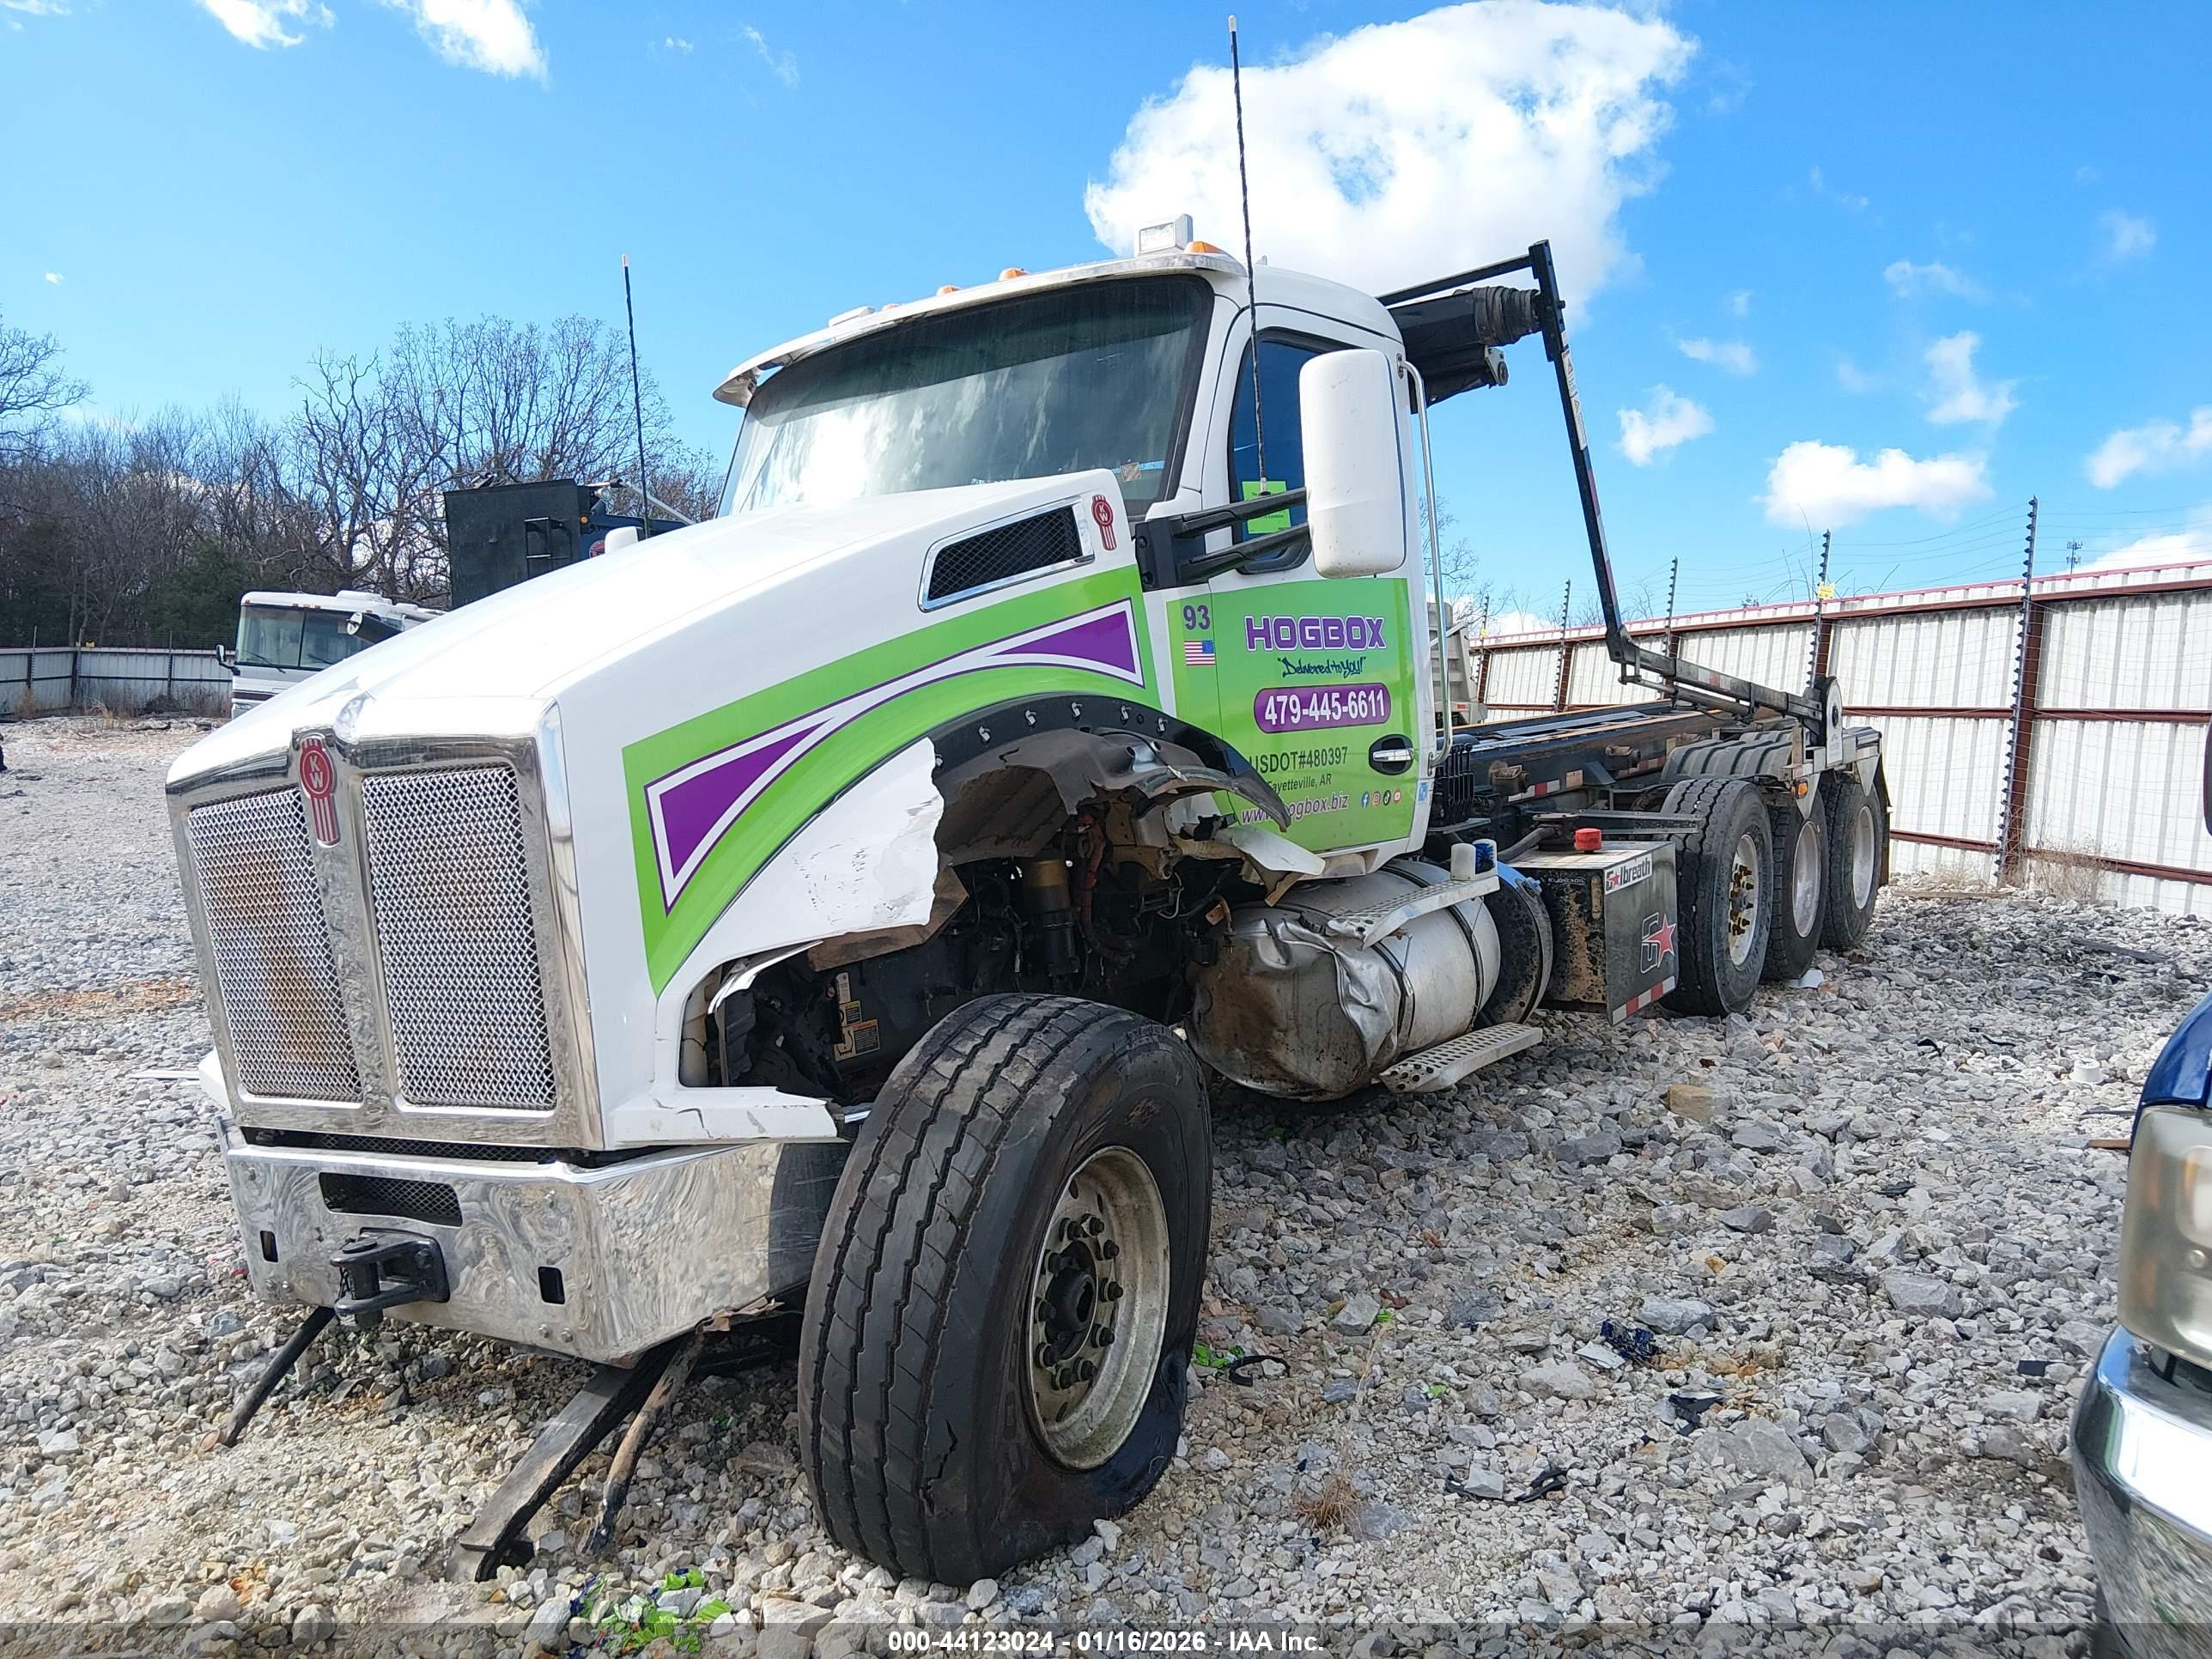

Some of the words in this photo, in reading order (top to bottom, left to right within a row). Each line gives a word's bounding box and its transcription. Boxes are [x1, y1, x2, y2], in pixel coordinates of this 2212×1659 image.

[1182, 604, 1211, 630] 93
[1244, 615, 1387, 652] HOGBOX
[1265, 690, 1385, 725] 479-445-6611
[1249, 745, 1348, 774] USDOT#480397
[1319, 773, 1332, 787] AR
